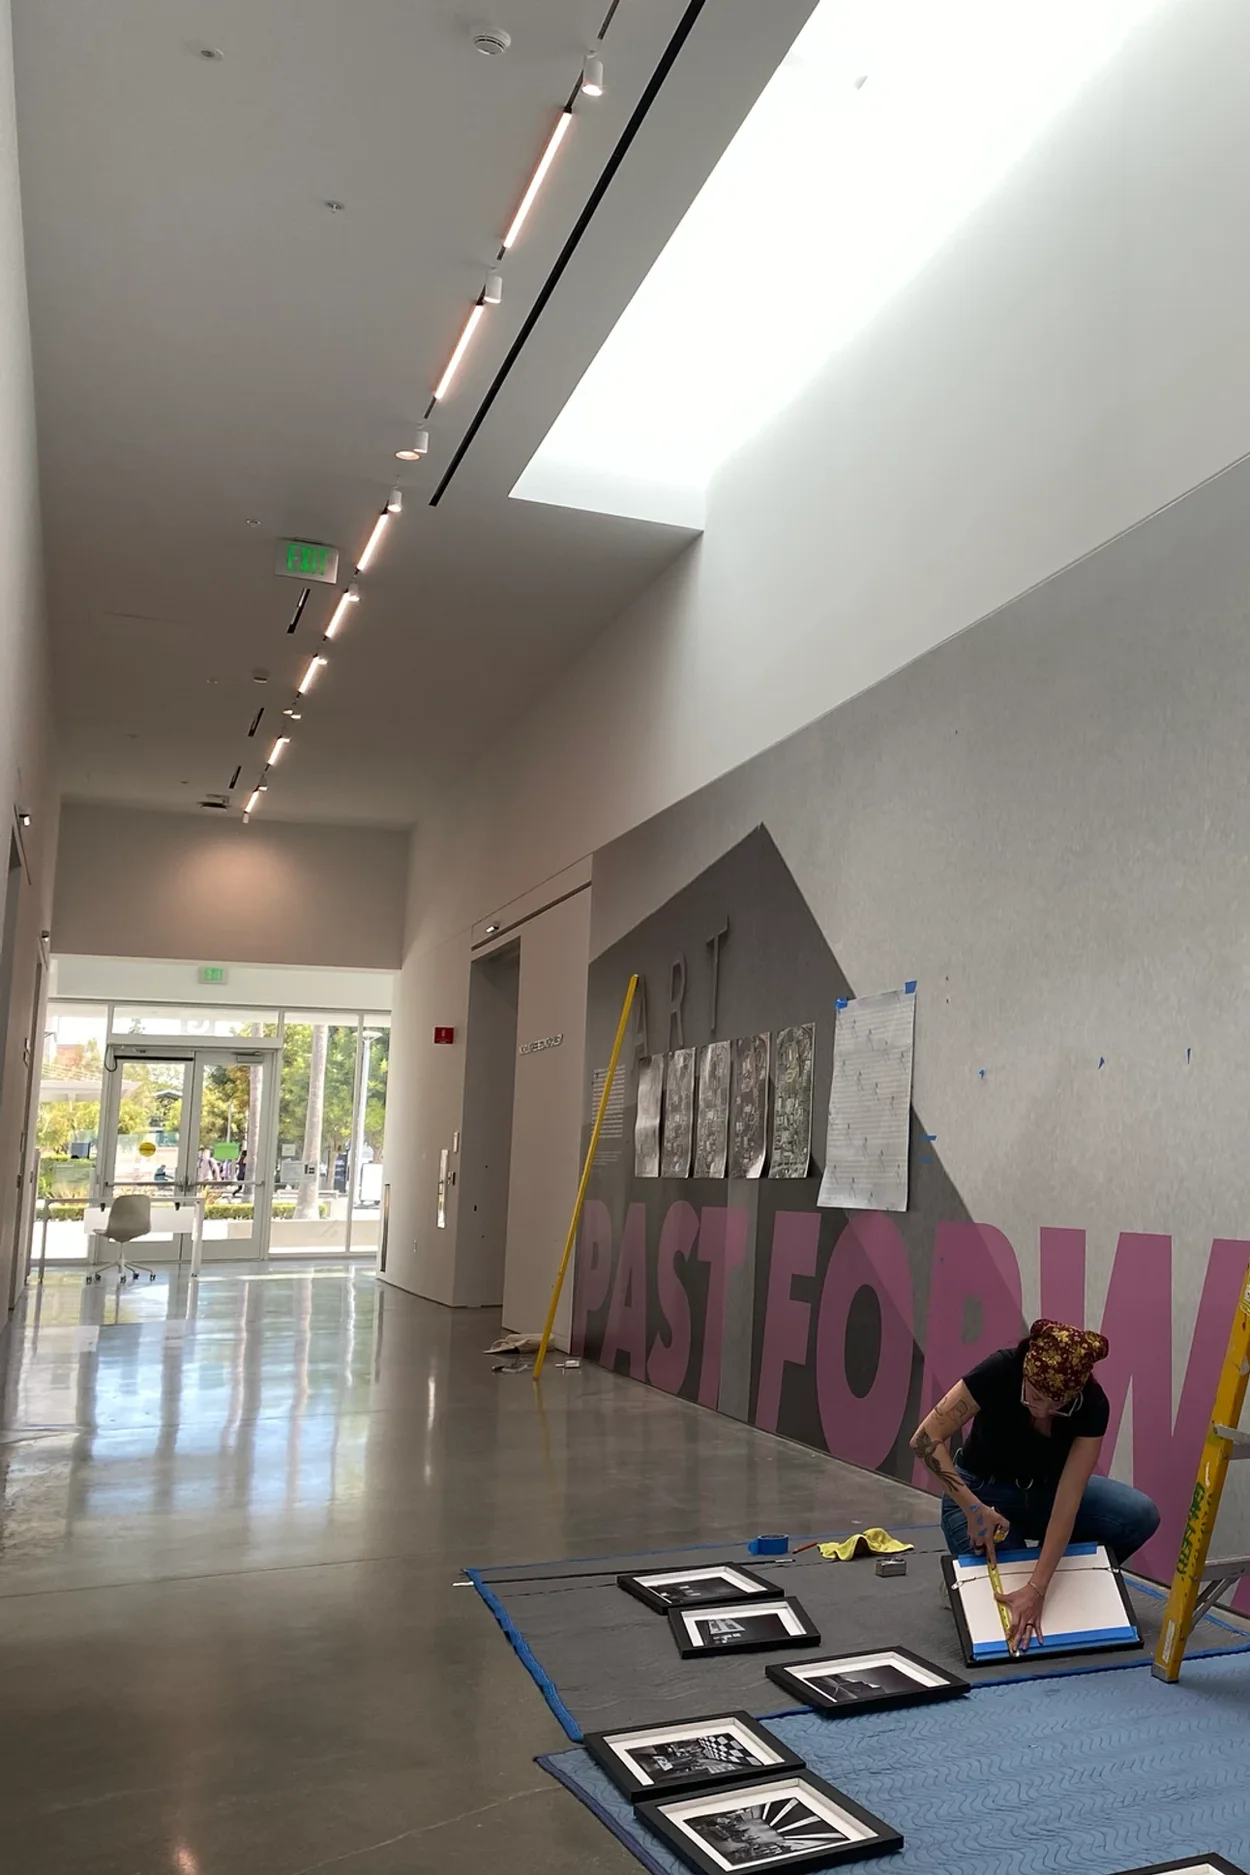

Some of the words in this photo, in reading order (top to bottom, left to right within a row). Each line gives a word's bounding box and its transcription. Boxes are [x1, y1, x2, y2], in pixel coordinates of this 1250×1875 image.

[287, 543, 328, 577] EXIT
[631, 914, 731, 1070] ART
[571, 1199, 749, 1411] PAST
